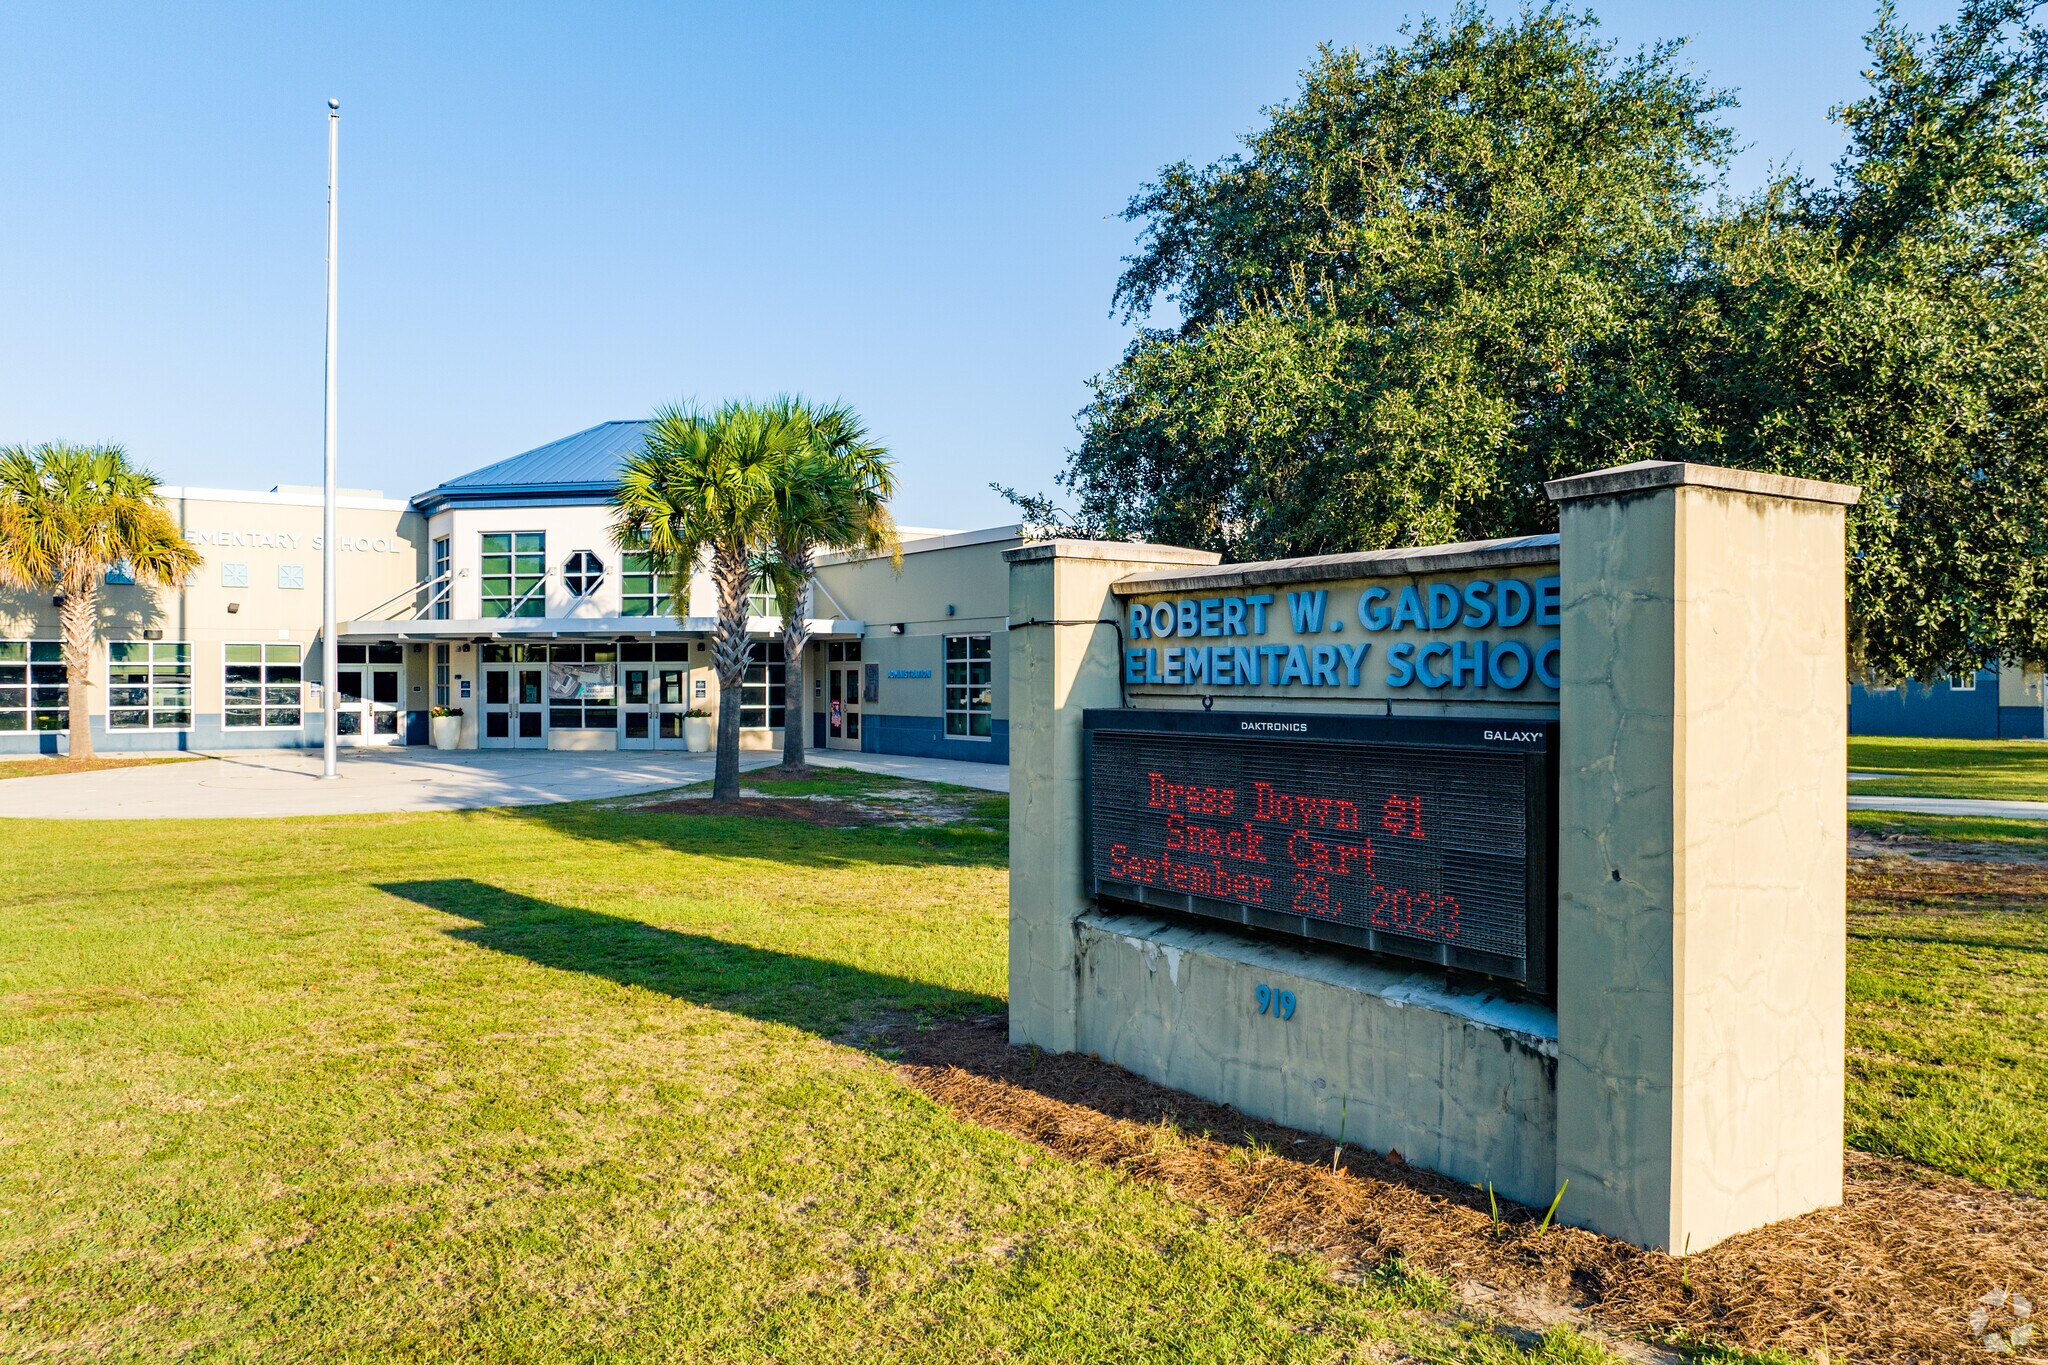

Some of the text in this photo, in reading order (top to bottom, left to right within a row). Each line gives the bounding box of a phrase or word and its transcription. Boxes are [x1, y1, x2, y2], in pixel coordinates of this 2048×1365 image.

[184, 528, 401, 553] EMENTARY SHOOL
[1129, 576, 1561, 639] ROBERT W. GADSDE
[1125, 638, 1561, 689] ELEMENTARY SCHOO
[1241, 721, 1308, 732] DAKTRONICS
[1148, 772, 1234, 815] Dress
[1254, 782, 1359, 830] Down
[1167, 813, 1375, 878] Snack Cart
[1111, 843, 1271, 903] September
[1370, 885, 1460, 938] 2023
[1256, 983, 1297, 1021] 919
